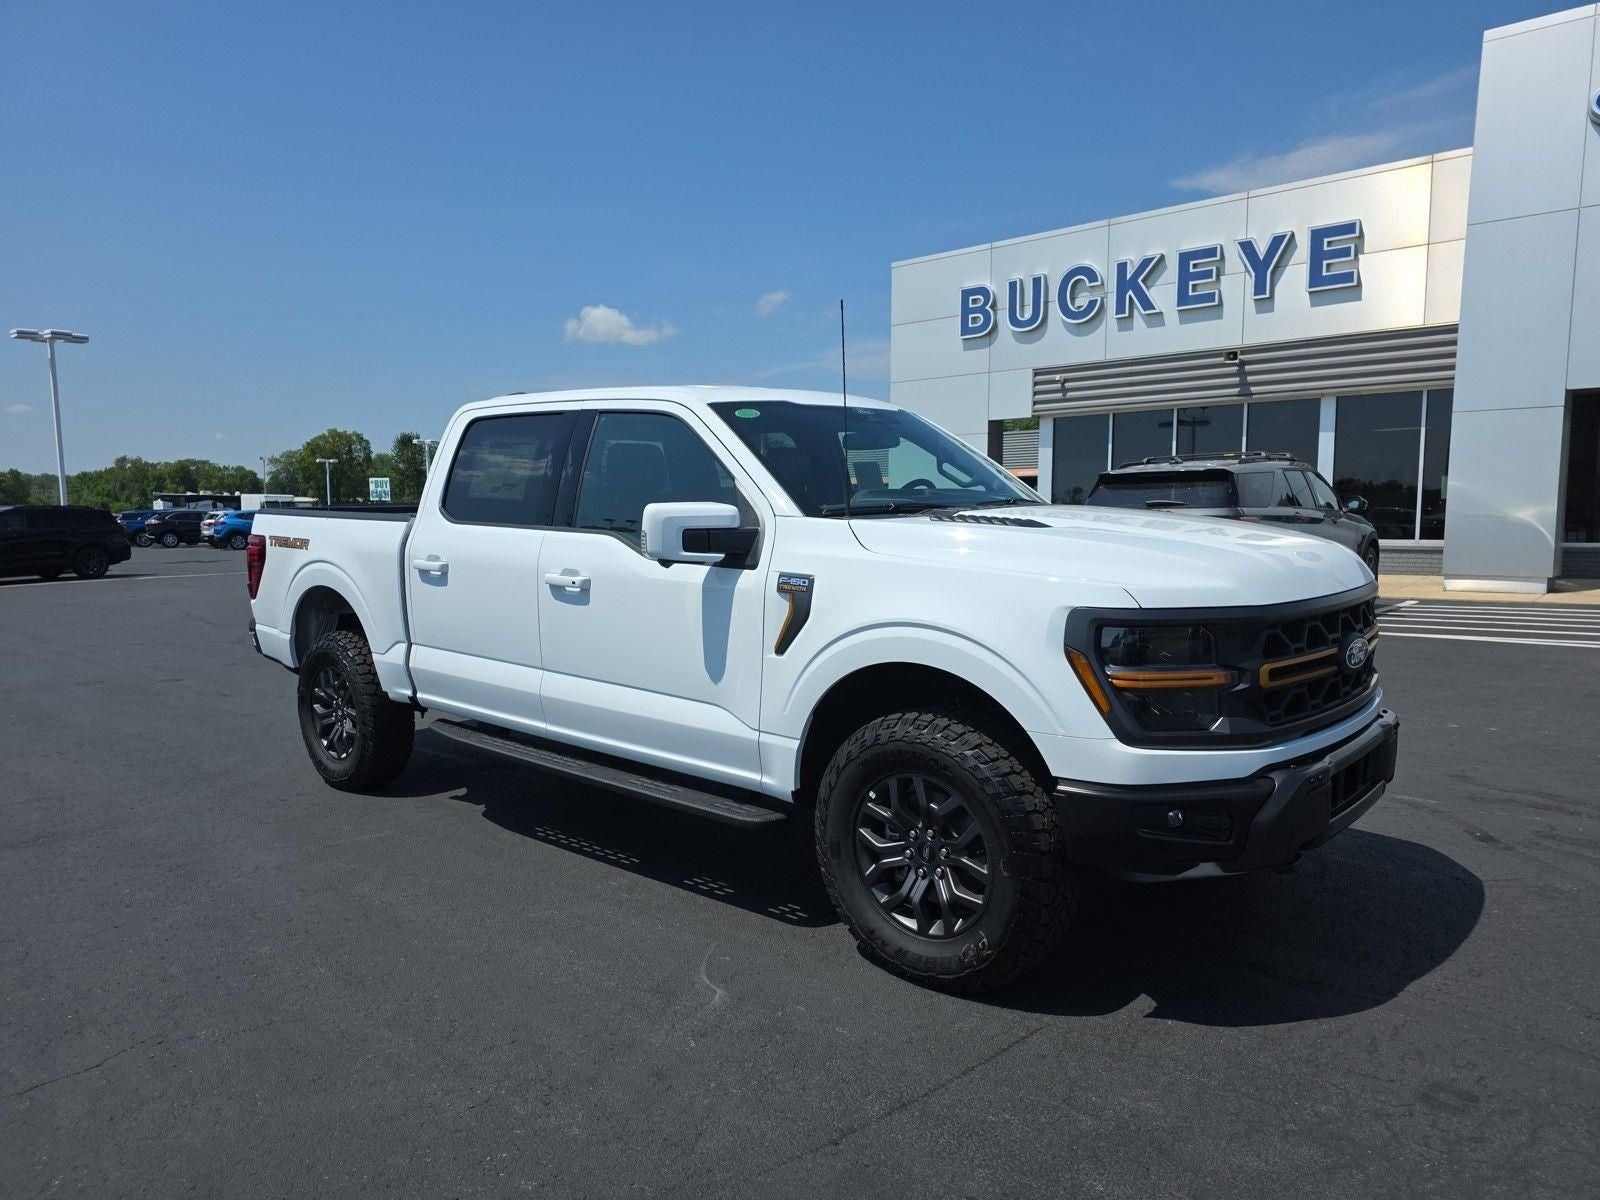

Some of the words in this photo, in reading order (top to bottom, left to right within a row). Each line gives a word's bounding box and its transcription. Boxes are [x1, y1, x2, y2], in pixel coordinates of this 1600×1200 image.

[958, 219, 1362, 340] BUCKEYE
[374, 479, 389, 489] BUY
[269, 535, 310, 550] TREMOR
[779, 576, 809, 586] F-150
